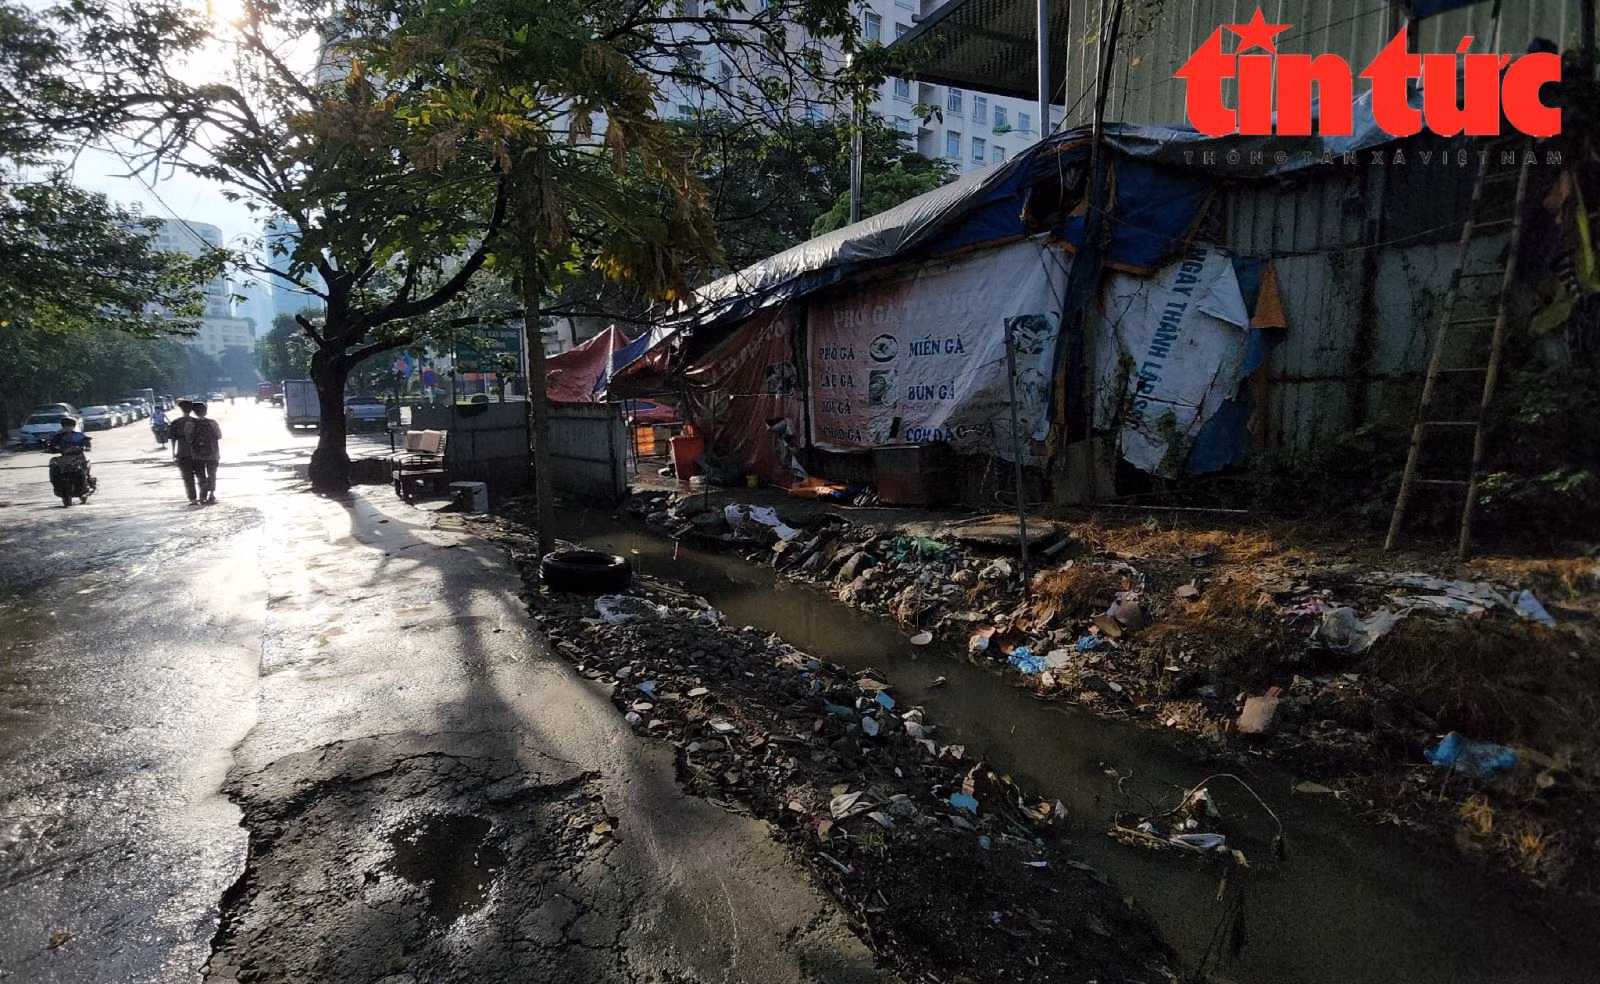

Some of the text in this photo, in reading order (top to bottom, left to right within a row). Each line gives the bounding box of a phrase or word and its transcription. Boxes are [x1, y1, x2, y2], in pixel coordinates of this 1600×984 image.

[1173, 248, 1208, 297] NGÀY
[909, 333, 965, 357] MIẾN GÀ
[1147, 302, 1188, 359] THÀNH
[908, 381, 934, 401] BÚN
